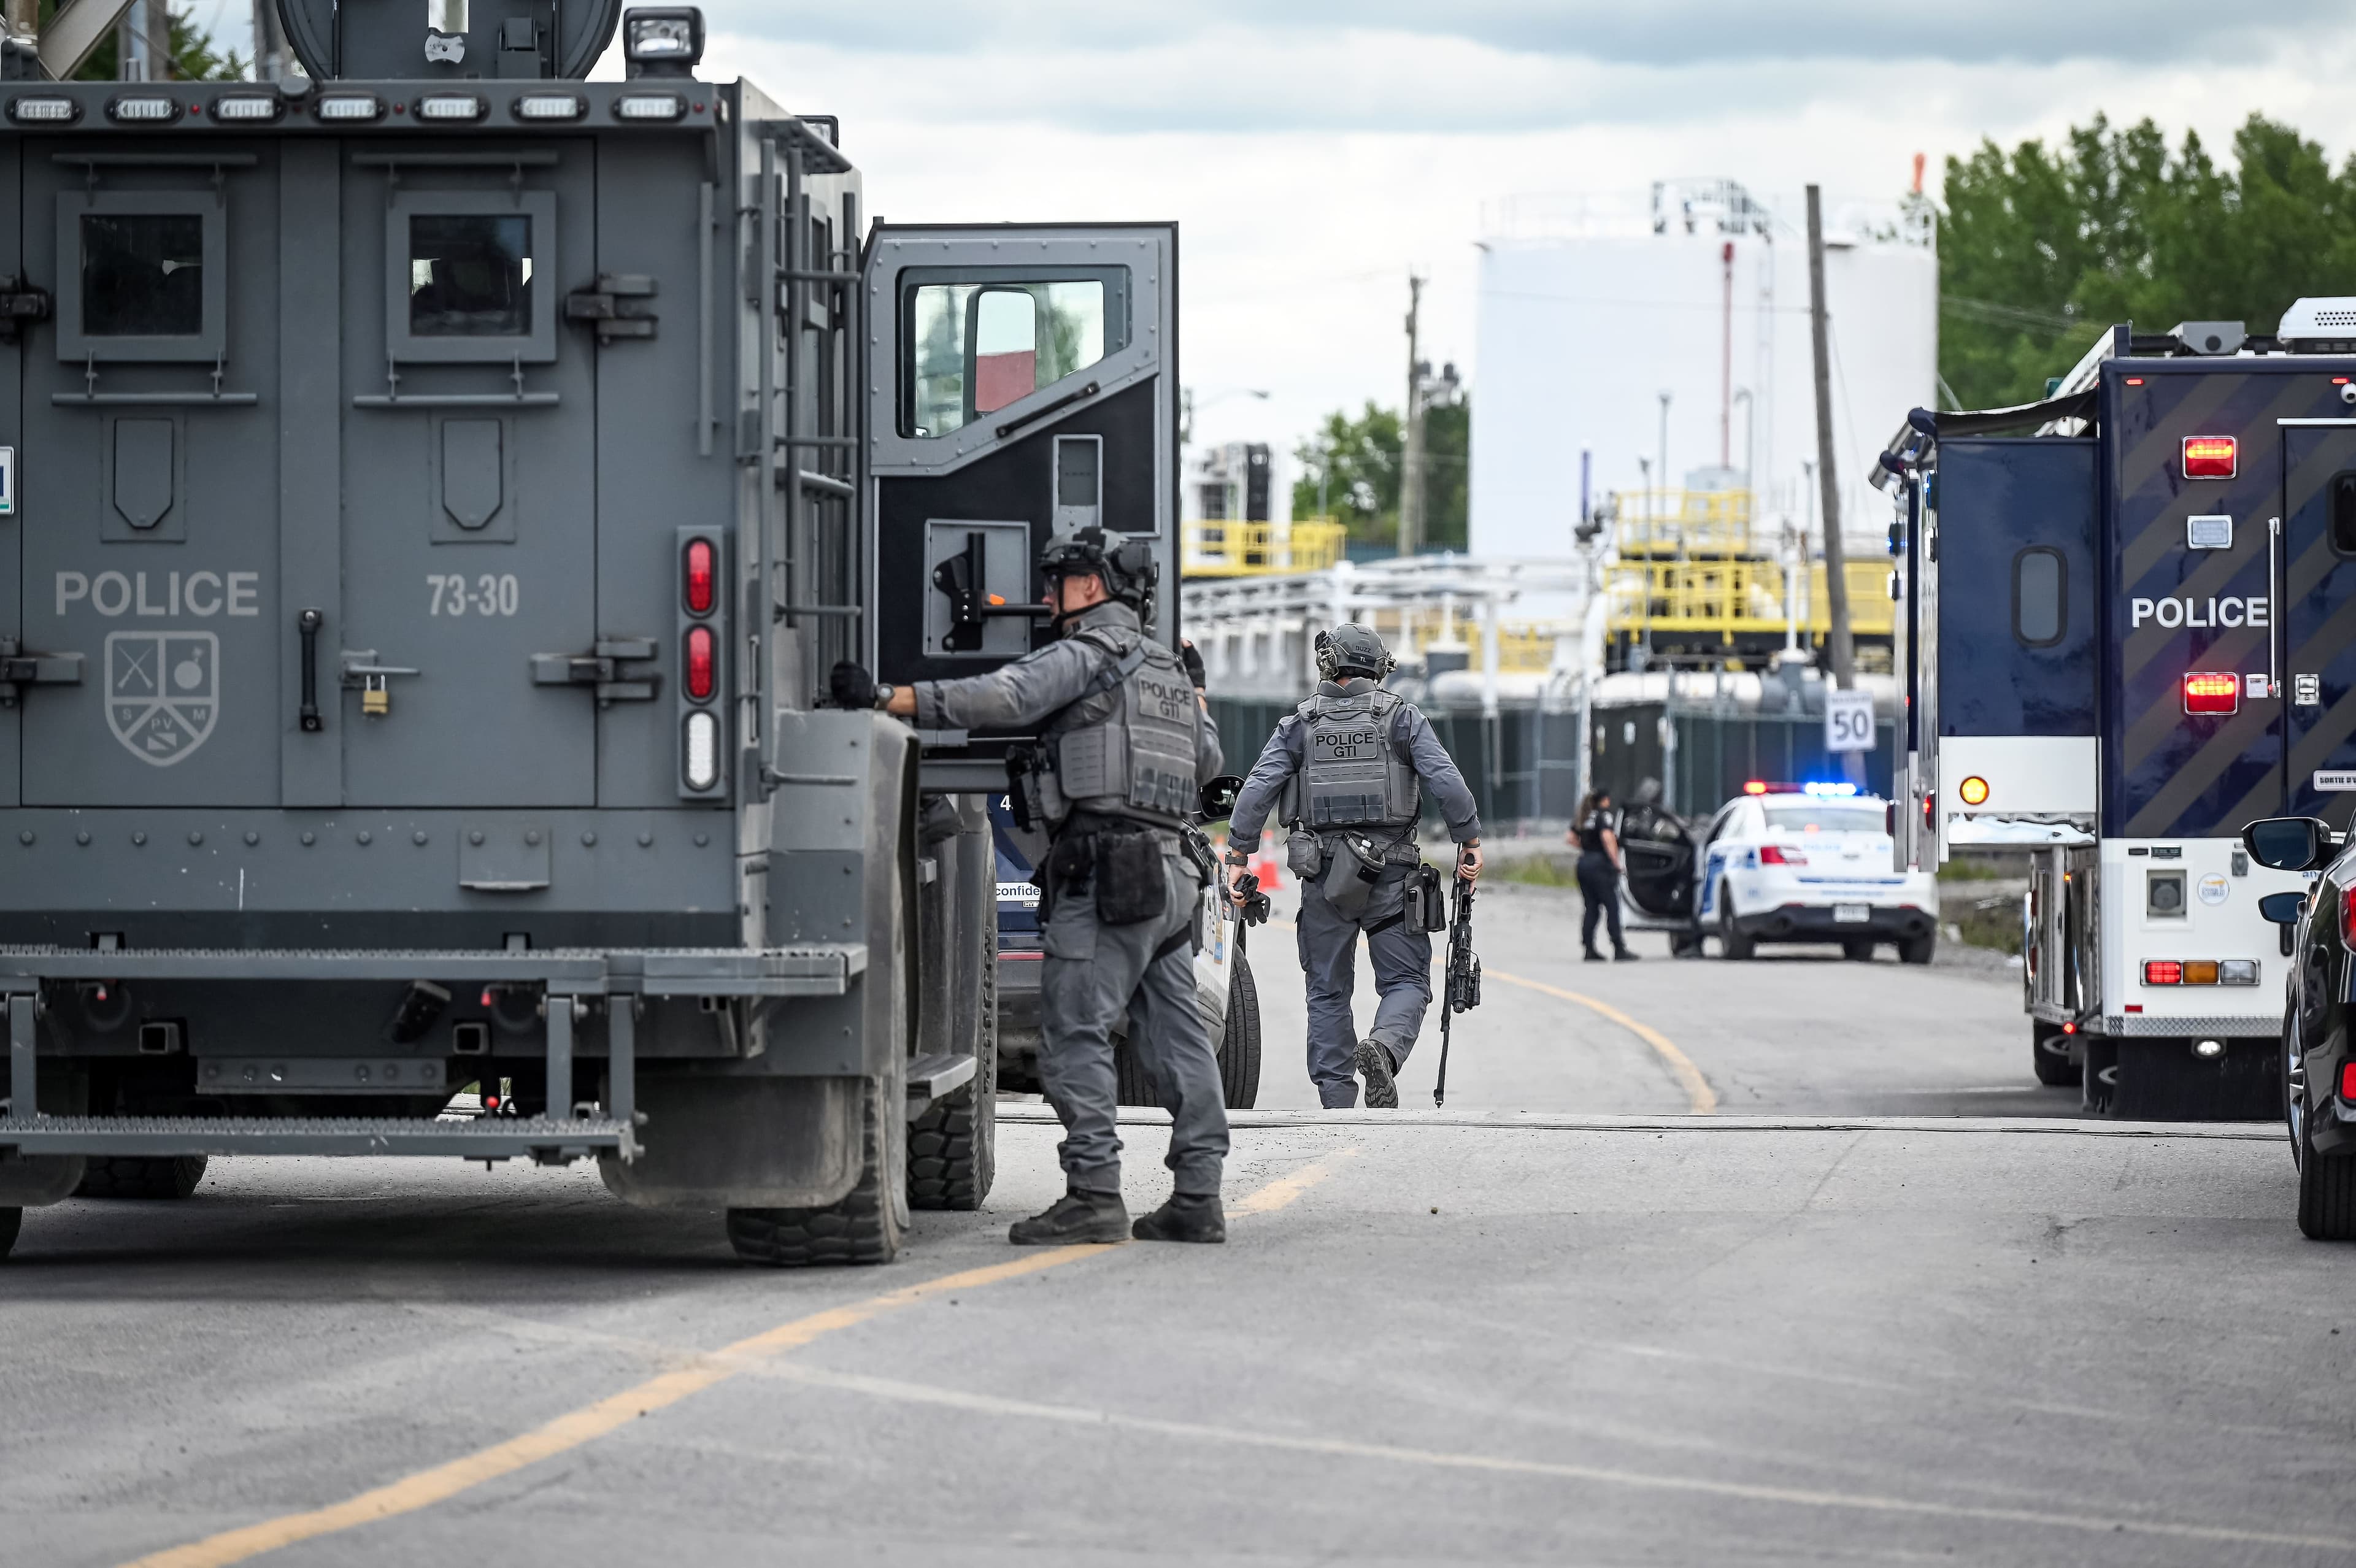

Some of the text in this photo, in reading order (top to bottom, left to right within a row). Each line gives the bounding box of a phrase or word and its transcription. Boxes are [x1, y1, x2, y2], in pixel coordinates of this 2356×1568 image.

[56, 571, 258, 615] POLICE
[426, 574, 519, 616] 73-30
[2131, 597, 2269, 628] POLICE
[1141, 680, 1191, 706] POLICE
[1160, 701, 1180, 719] GTI
[1834, 710, 1869, 742] 50
[1315, 732, 1374, 747] POLICE
[1333, 745, 1357, 758] GTI
[1000, 795, 1014, 811] 4
